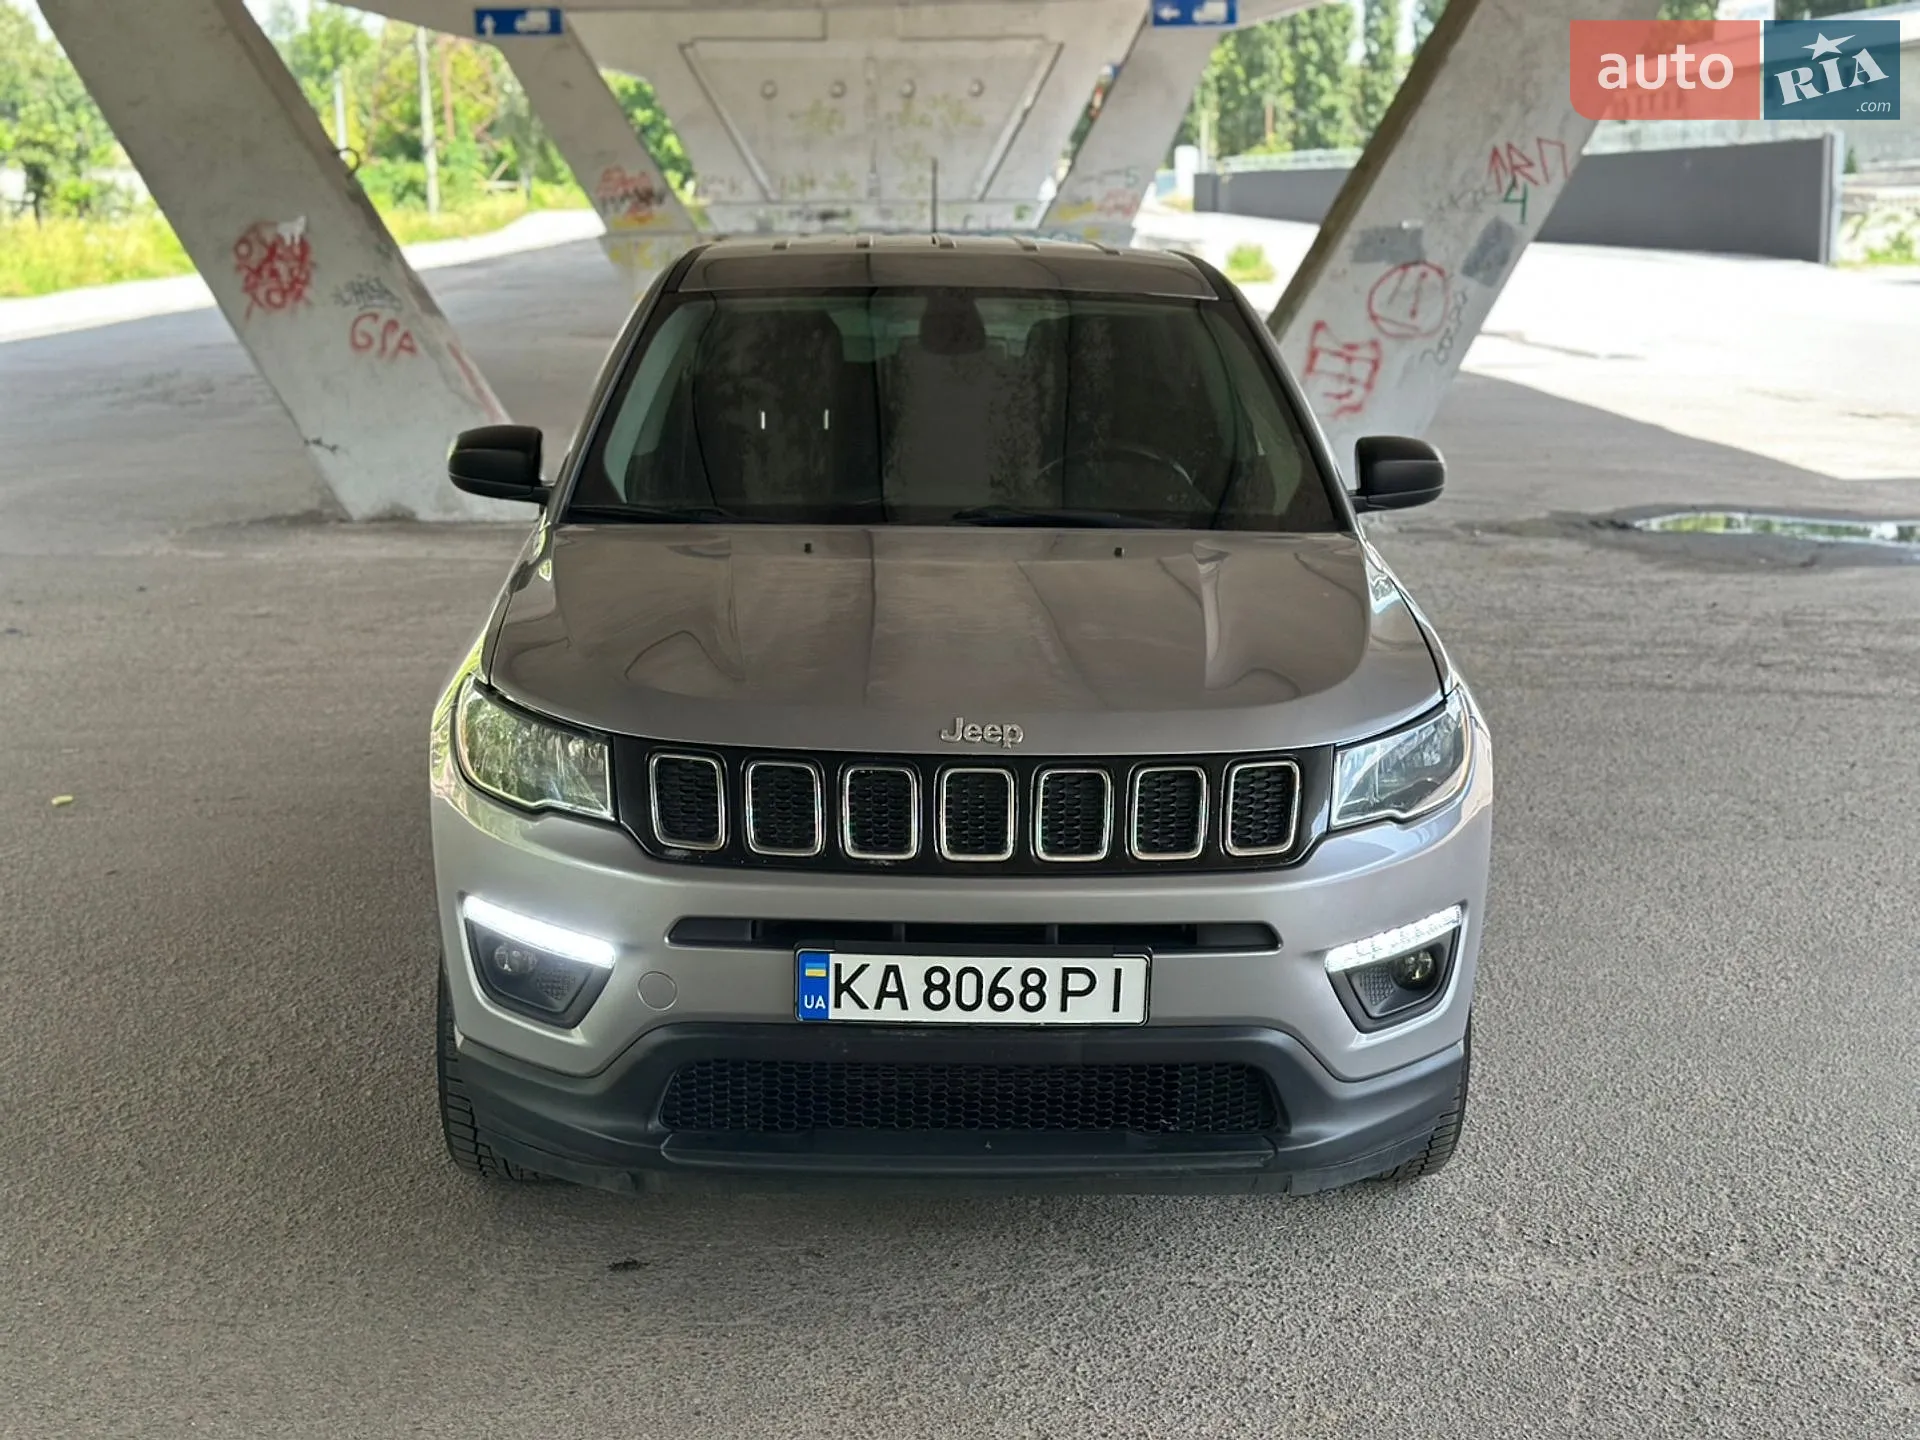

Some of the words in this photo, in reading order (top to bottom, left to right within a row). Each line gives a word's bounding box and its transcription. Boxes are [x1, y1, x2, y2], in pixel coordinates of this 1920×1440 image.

[940, 717, 1024, 749] Jeep
[804, 994, 827, 1010] UA
[833, 962, 909, 1012] KA
[922, 965, 1048, 1014] 8068
[1059, 965, 1123, 1014] PI
